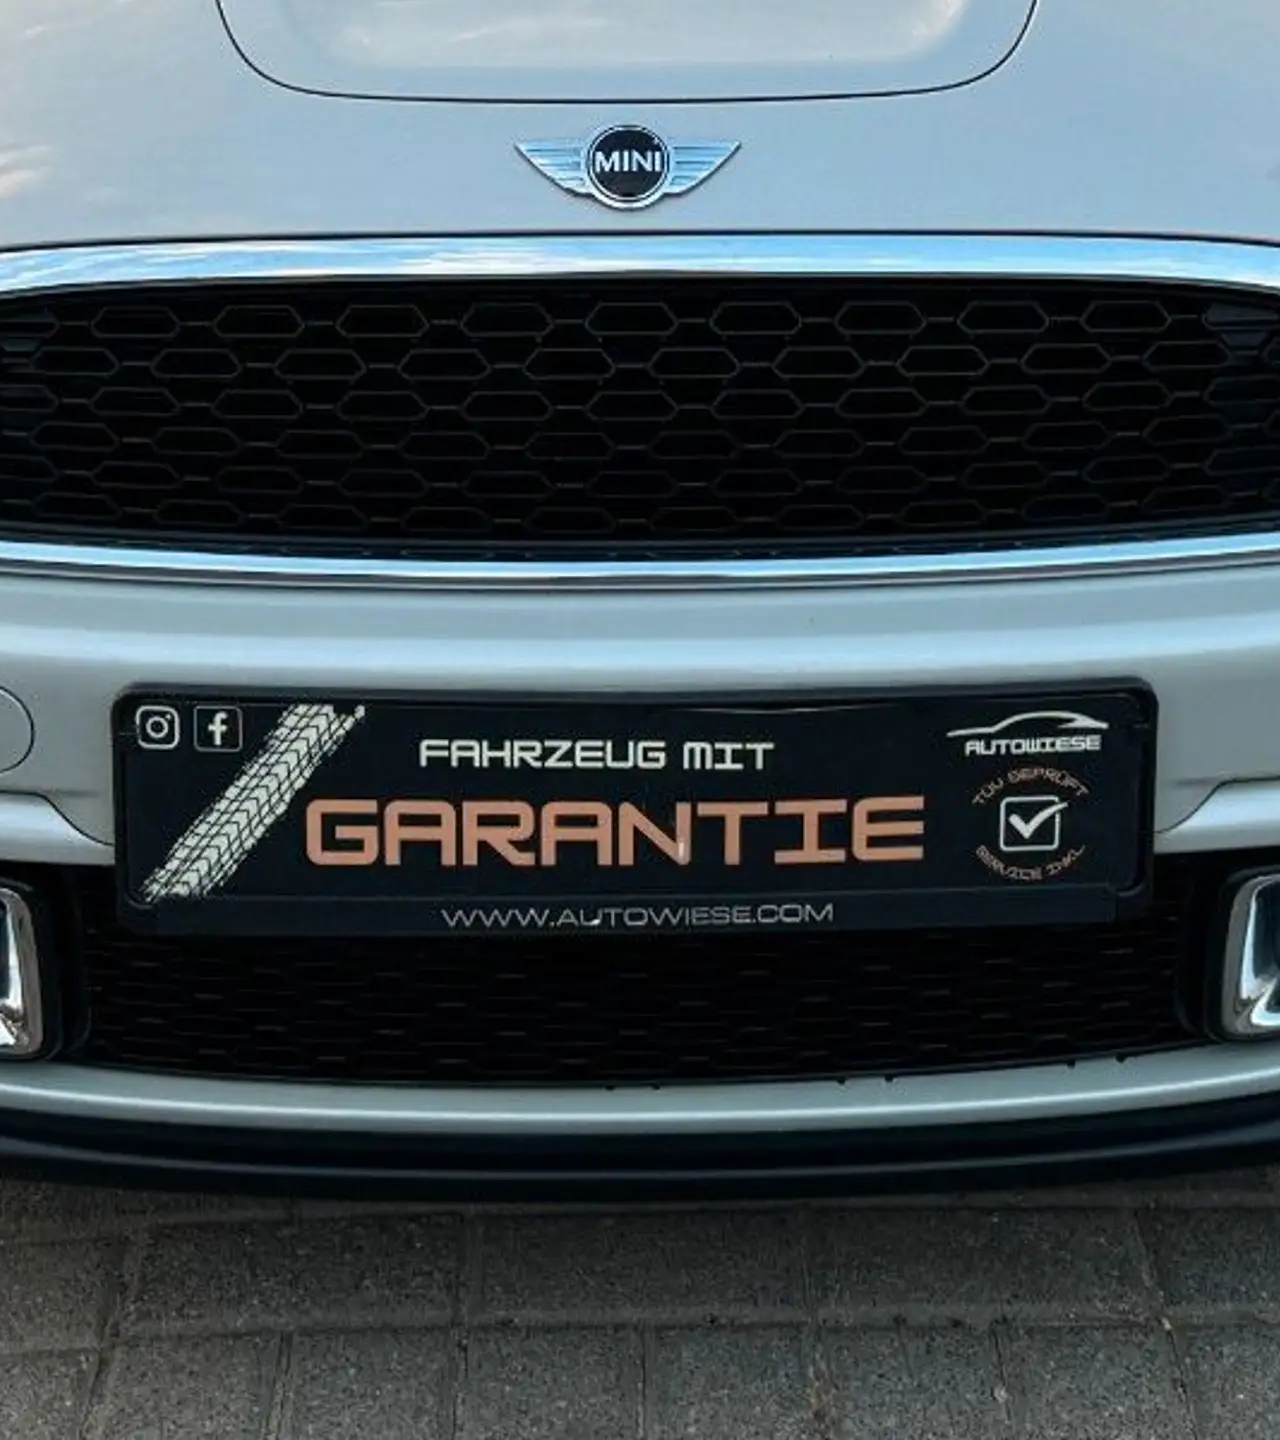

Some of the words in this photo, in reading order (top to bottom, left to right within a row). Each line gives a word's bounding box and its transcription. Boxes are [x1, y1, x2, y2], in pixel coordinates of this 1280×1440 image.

[594, 150, 663, 173] MINI
[419, 739, 668, 769] FAHRZEUG
[682, 741, 776, 771] MIT
[965, 734, 1102, 757] AUTOWIESE
[305, 795, 926, 866] GARANTIE
[440, 903, 835, 929] WWW.AUTOWIESE.COM
